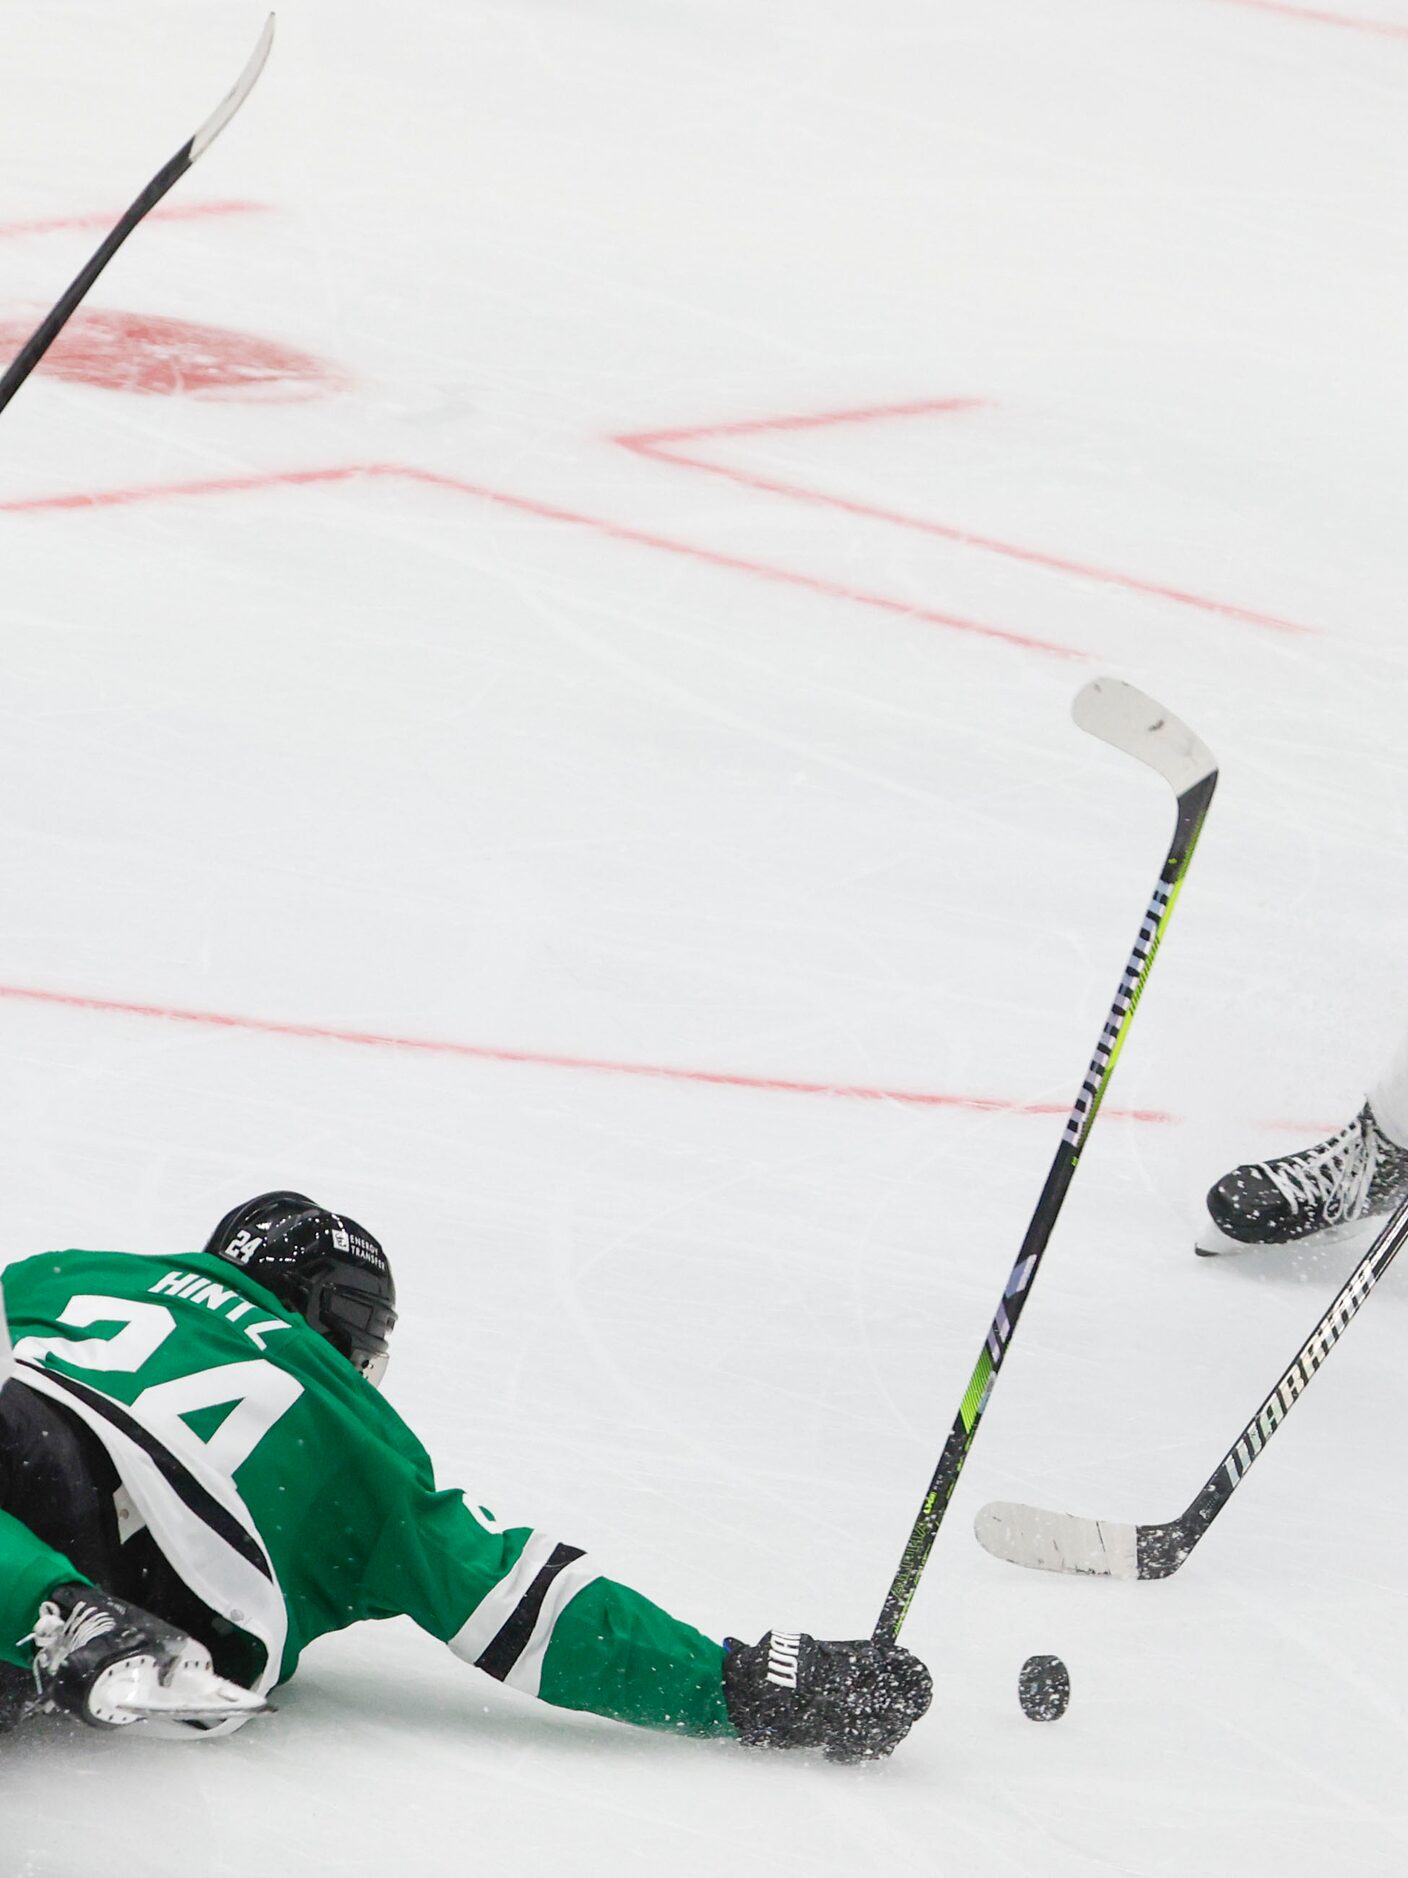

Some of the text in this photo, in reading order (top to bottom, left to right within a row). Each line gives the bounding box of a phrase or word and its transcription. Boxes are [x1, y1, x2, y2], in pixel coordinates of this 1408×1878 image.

[224, 1229, 263, 1264] 24
[349, 1233, 379, 1257] ENERGY
[350, 1243, 386, 1272] TRANSFER
[12, 1294, 306, 1481] 24
[1223, 1259, 1379, 1490] WARRIOR
[766, 1630, 801, 1689] WA
